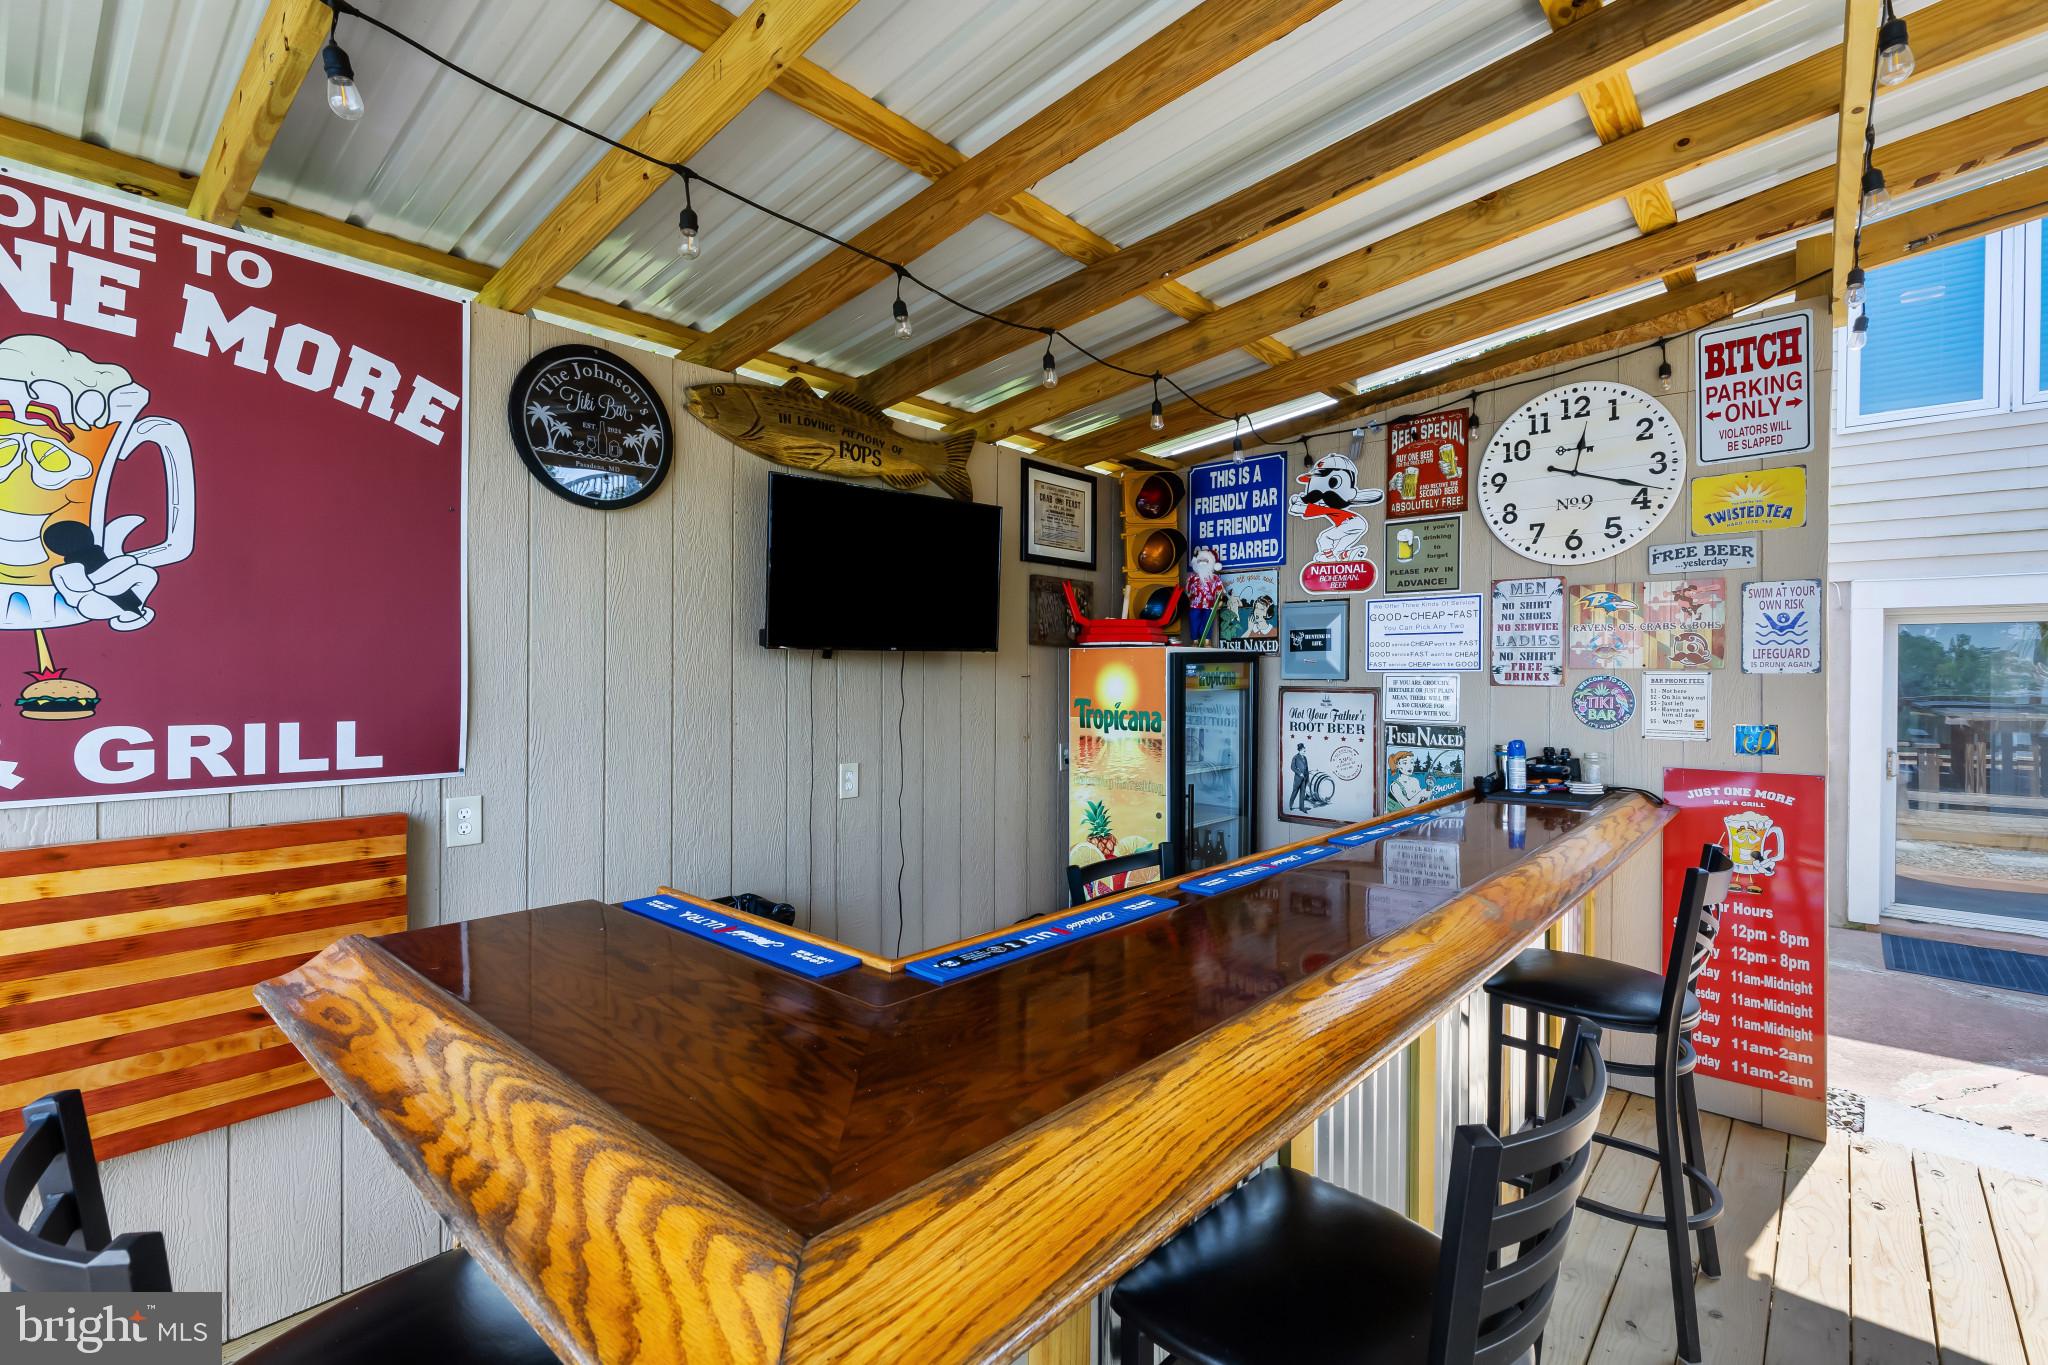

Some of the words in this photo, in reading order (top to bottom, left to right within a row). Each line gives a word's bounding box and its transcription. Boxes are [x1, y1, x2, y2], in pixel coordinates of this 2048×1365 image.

[182, 235, 274, 288] TO
[173, 283, 460, 446] MORE
[1704, 326, 1803, 381] BITCH
[536, 370, 570, 396] The
[571, 361, 649, 416] Johnson's
[1706, 371, 1803, 405] PARKING
[559, 386, 596, 412] Tiki
[598, 394, 633, 422] Bar
[1560, 395, 1591, 421] 12
[1608, 398, 1620, 422] 1
[1725, 395, 1782, 423] ONLY
[1409, 415, 1445, 426] TODAY'S
[1528, 412, 1551, 436] 11
[1635, 417, 1654, 442] 2
[1719, 423, 1768, 440] VIOLATORS
[1770, 420, 1792, 432] WILL
[779, 412, 792, 425] IN
[797, 415, 836, 433] LOVING
[841, 427, 886, 449] MEMORY
[891, 444, 904, 455] OF
[1420, 418, 1465, 447] SPECIAL
[1727, 441, 1739, 452] BE
[1741, 434, 1784, 450] SLAPPED
[839, 440, 882, 467] POPS
[1408, 451, 1419, 461] ONE
[1420, 449, 1434, 460] BEER
[1502, 439, 1531, 464] 10
[608, 465, 621, 473] MD
[1648, 451, 1668, 475] 3
[1209, 468, 1237, 489] THIS
[1238, 466, 1250, 486] IS
[1253, 464, 1262, 483] A
[1490, 472, 1508, 494] 9
[1194, 491, 1249, 515] FRIENDLY
[1252, 487, 1278, 508] BAR
[1420, 488, 1442, 498] SECOND
[1444, 486, 1459, 495] BEER
[1630, 487, 1652, 511] 4
[1392, 499, 1440, 513] ABSOLUTELY
[1442, 495, 1464, 507] FREE!
[1502, 503, 1518, 525] 8
[1704, 505, 1765, 527] TWISTED
[1766, 503, 1793, 520] TEA
[1199, 520, 1214, 539] BE
[1216, 513, 1272, 537] FRIENDLY
[1423, 533, 1452, 541] drinking
[1529, 522, 1546, 545] 7
[1603, 516, 1623, 540] 5
[1229, 538, 1279, 561] BARRED
[1565, 528, 1583, 551] 6
[1427, 552, 1448, 560] forget
[1651, 545, 1698, 566] FREE
[1703, 543, 1755, 558] BEER
[1310, 564, 1367, 576] NATIONAL
[1389, 568, 1420, 576] PLEASE
[1423, 566, 1439, 574] PAY
[1330, 581, 1348, 589] BEER
[1396, 577, 1448, 588] ADVANCE!
[1510, 581, 1546, 595] MEN
[1748, 587, 1773, 599] SWIM
[1775, 586, 1787, 597] AT
[1790, 585, 1815, 597] YOUR
[1502, 602, 1514, 610] NO
[1519, 600, 1552, 610] SHIRT
[1759, 599, 1782, 610] OWN
[1784, 598, 1805, 610] RISK
[1519, 611, 1552, 620] SHOES
[1640, 621, 1677, 631] CRABS
[1692, 621, 1722, 629] BOHS
[1383, 624, 1397, 632] You
[1399, 623, 1413, 631] Can
[1415, 623, 1431, 631] Pick
[1433, 623, 1447, 631] Any
[1497, 623, 1511, 632] NO
[1514, 622, 1559, 632] SERVICE
[1495, 634, 1560, 647] LADIES
[1499, 651, 1513, 661] NO
[1519, 651, 1556, 661] SHIRT
[1752, 647, 1810, 660] LIFEGUARD
[1504, 672, 1549, 681] DRINKS
[1510, 662, 1543, 671] FREE
[1587, 696, 1614, 709] TIKI
[1074, 697, 1163, 734] Tropicana
[1289, 706, 1305, 720] Not
[1306, 707, 1328, 723] Your
[1330, 708, 1366, 723] Father's
[1588, 708, 1618, 721] BAR
[1289, 721, 1325, 733] ROOT
[1327, 722, 1366, 735] BEER
[1387, 725, 1416, 745] FISH
[1416, 726, 1464, 747] NAKED
[73, 720, 384, 786] GRILL
[1687, 787, 1720, 800] JUST
[1723, 786, 1751, 797] ONE
[1754, 789, 1796, 806] MORE
[1741, 800, 1766, 808] GRILL
[1733, 902, 1774, 919] Hours
[1731, 923, 1768, 942] 12pm
[1779, 930, 1810, 949] 8pm
[1731, 946, 1768, 965] 12pm
[1780, 953, 1811, 972] 8pm
[1731, 970, 1814, 996] 11am-Midnight
[1695, 988, 1721, 1005] esday
[1731, 993, 1814, 1019] 11am-Midnight
[1731, 1015, 1814, 1042] 11am-Midnight
[1692, 1031, 1721, 1048] day
[1732, 1038, 1814, 1065] 11am-2am
[1732, 1060, 1814, 1089] 11am-2am
